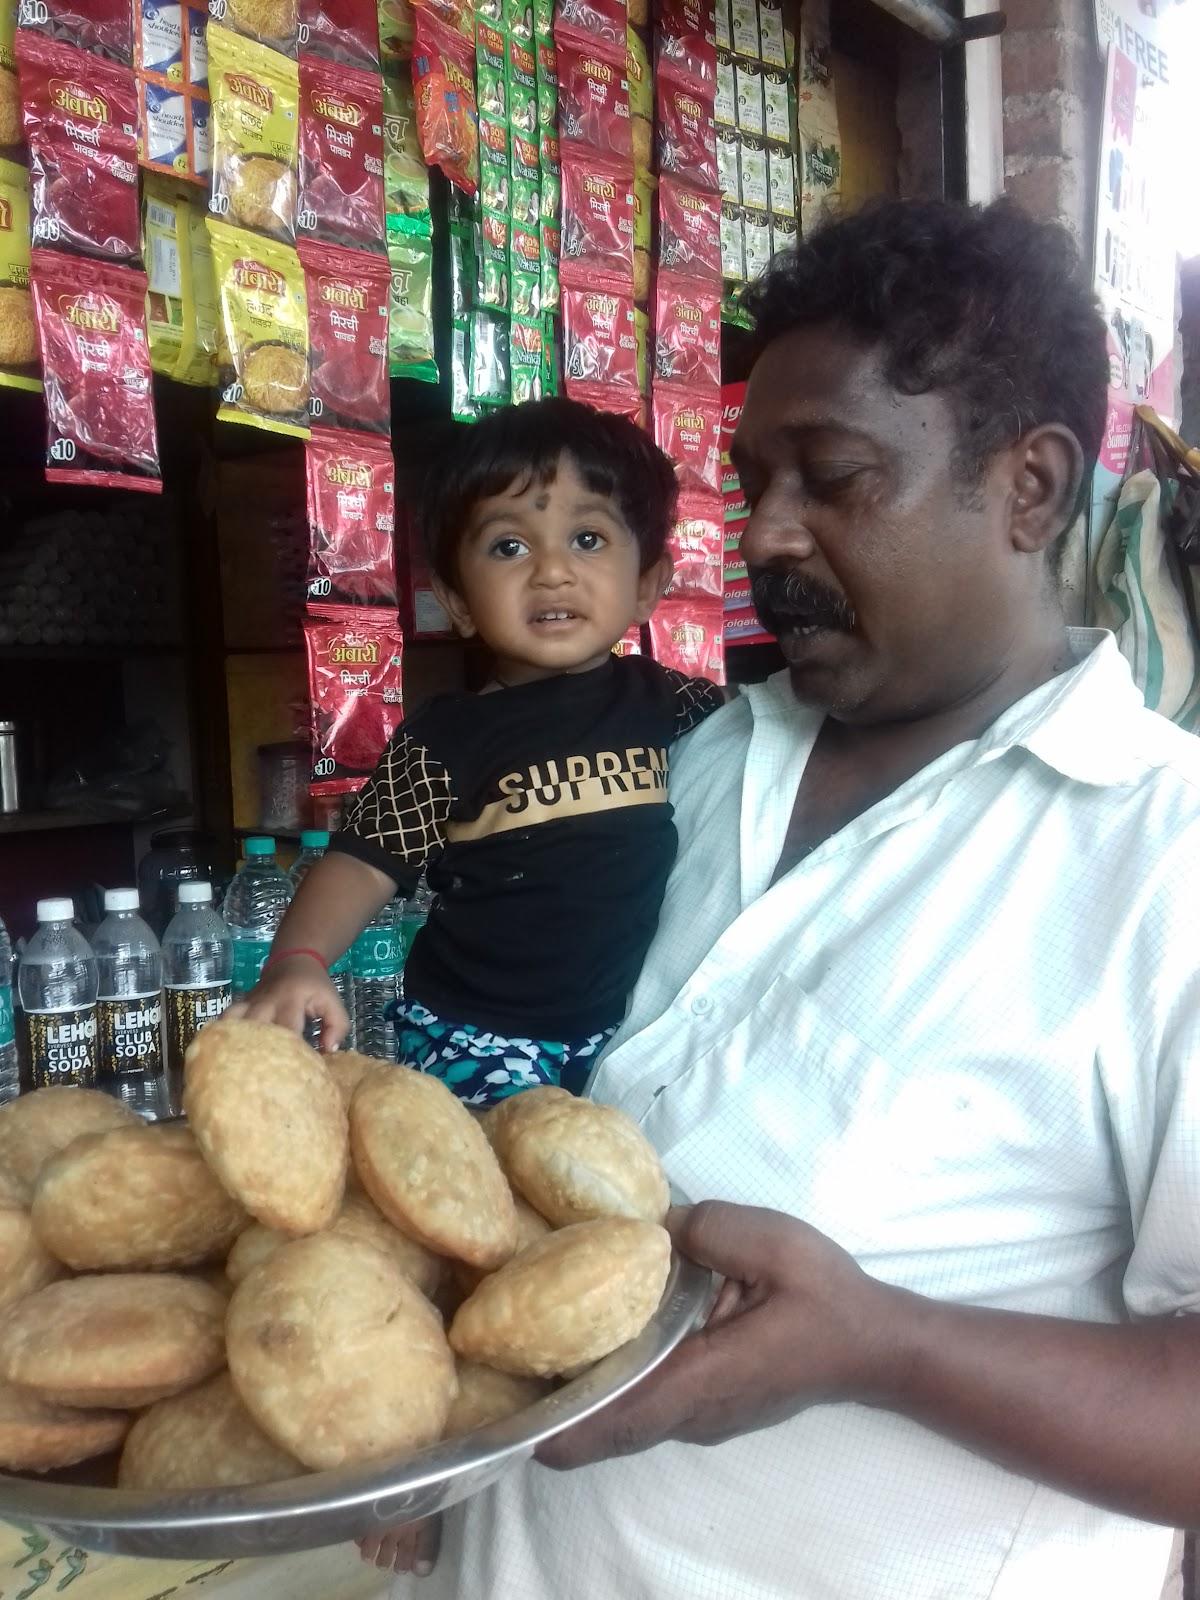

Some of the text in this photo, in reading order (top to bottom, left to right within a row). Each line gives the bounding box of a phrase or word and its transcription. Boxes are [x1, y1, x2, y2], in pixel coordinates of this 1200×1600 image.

[325, 124, 355, 148] मिरची
[329, 310, 360, 333] मिरची
[50, 438, 76, 461] ₹10
[332, 640, 379, 664] अंबारी
[340, 670, 371, 686] मिरची
[314, 758, 336, 776] ₹10
[115, 1030, 153, 1047] CLUB
[47, 1045, 87, 1061] CLUB
[115, 1042, 156, 1058] SODA
[48, 1056, 92, 1073] SODA
